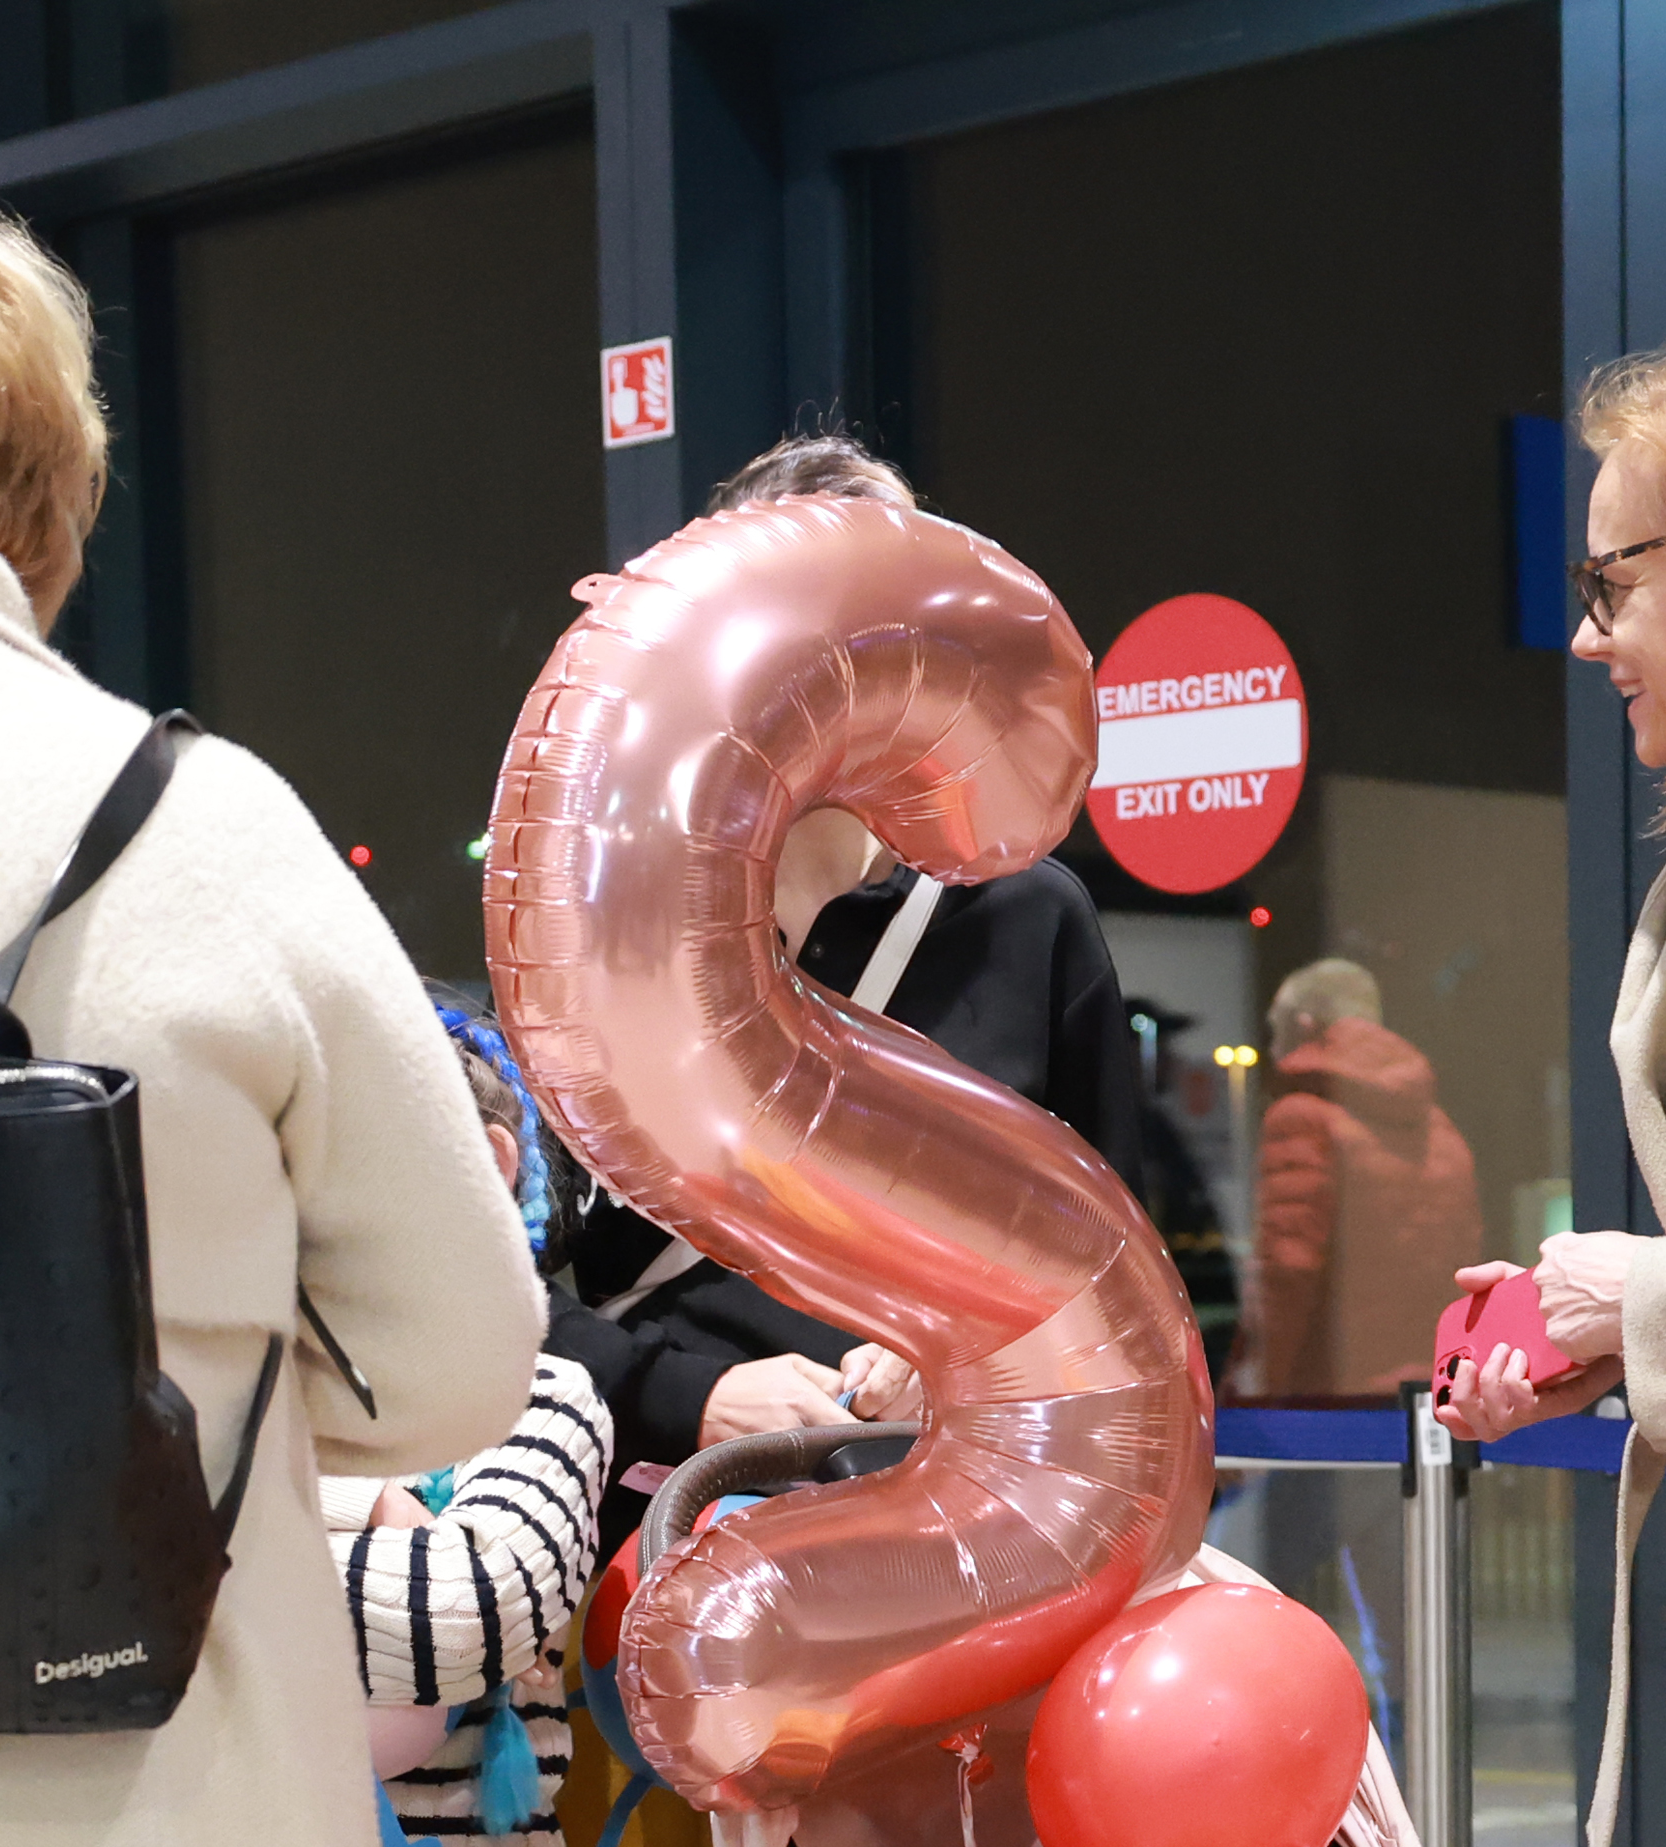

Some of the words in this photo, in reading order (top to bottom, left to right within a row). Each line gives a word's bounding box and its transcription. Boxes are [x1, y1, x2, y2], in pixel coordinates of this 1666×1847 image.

[1097, 665, 1287, 718] EMERGENCY
[1116, 782, 1182, 820] EXIT
[1188, 773, 1270, 812] ONLY
